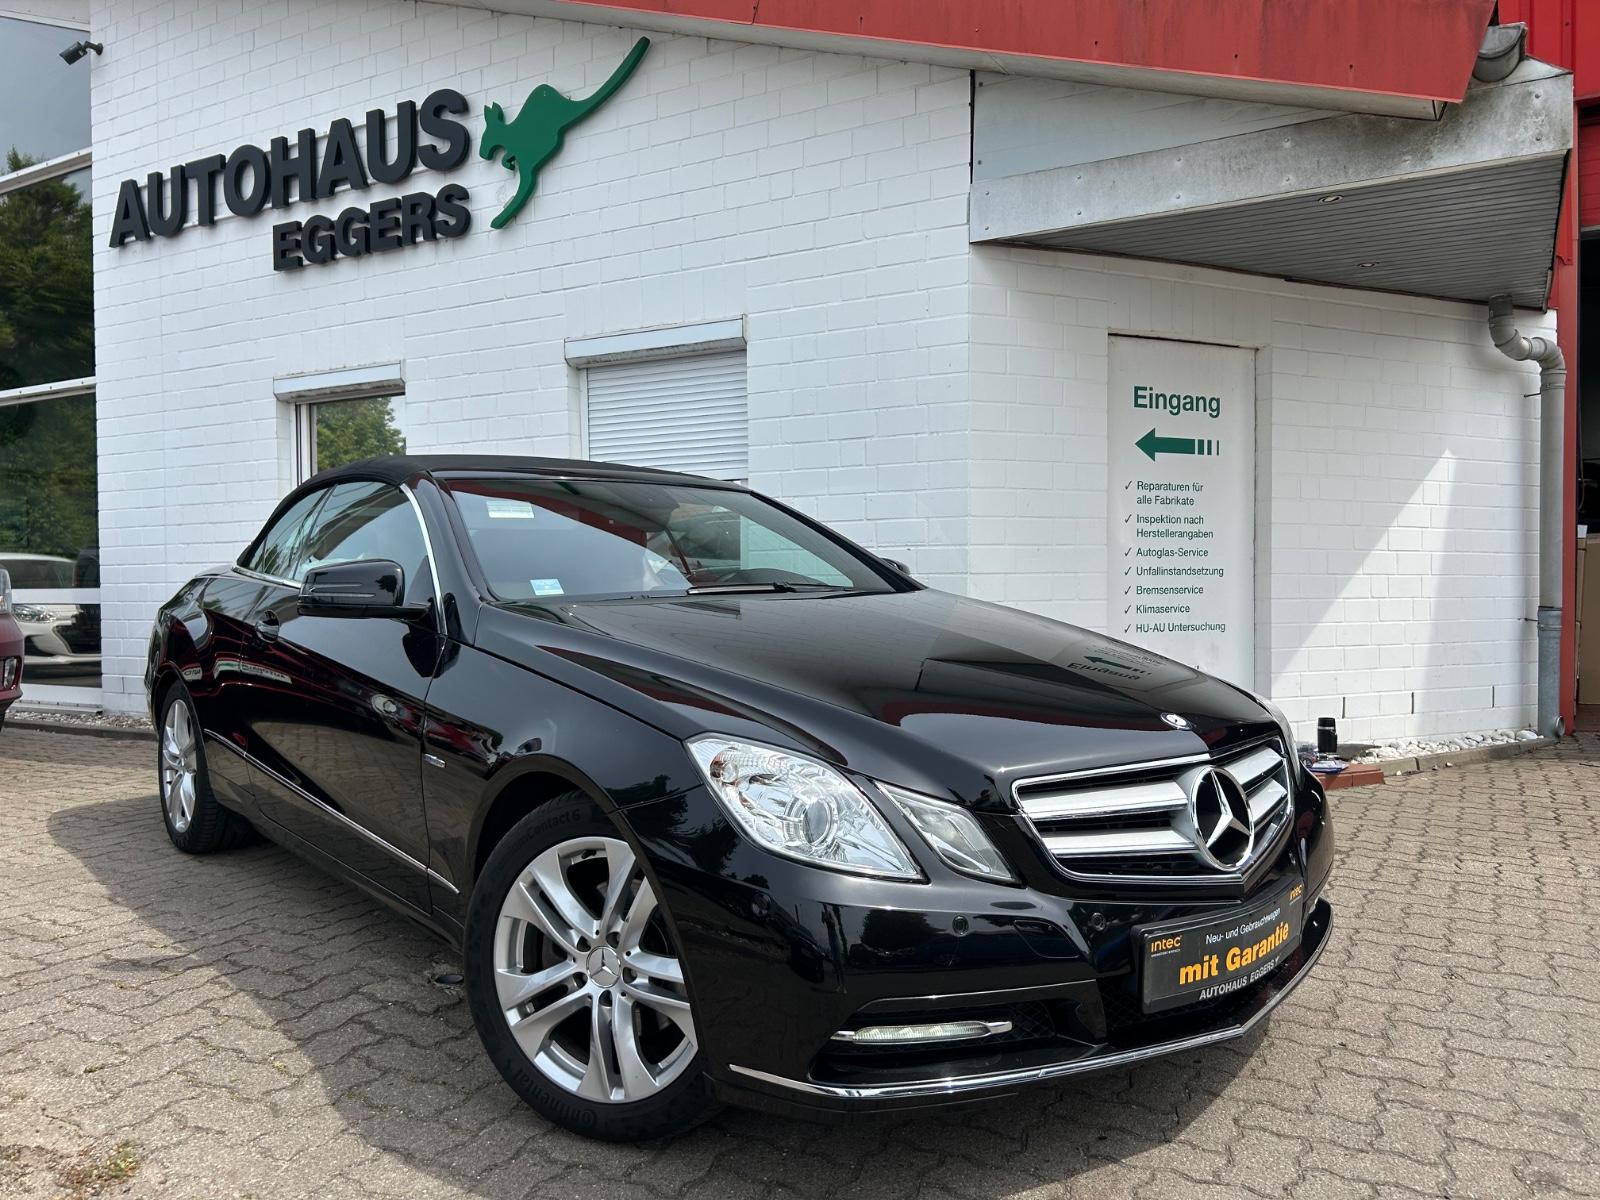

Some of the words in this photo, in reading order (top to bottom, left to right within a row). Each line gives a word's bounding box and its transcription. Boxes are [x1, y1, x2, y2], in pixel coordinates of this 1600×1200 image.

[109, 88, 470, 248] AUTOHAUS
[273, 183, 471, 272] EGGERS
[1133, 386, 1220, 418] Eingang
[1137, 481, 1190, 492] Reparaturen
[1192, 482, 1204, 492] für
[1136, 495, 1152, 504] alle
[1154, 495, 1195, 505] Fabrikate
[1136, 514, 1181, 525] Inspektion
[1184, 515, 1204, 524] nach
[1136, 528, 1214, 540] Herstellerangaben
[1136, 548, 1209, 559] Autoglas-Service
[1136, 566, 1224, 577] Unfallinstandsetzung
[1136, 585, 1204, 595] Bremsenservice
[1136, 605, 1190, 614] Klimaservice
[1136, 623, 1166, 633] HU-AU
[1167, 622, 1226, 632] Untersuchung
[1205, 934, 1224, 945] Neu-
[1225, 927, 1239, 939] und
[1151, 936, 1181, 953] intec
[1179, 954, 1219, 985] mit
[1226, 921, 1289, 971] Garantie
[1199, 976, 1248, 1001] AUTOHAUS
[1249, 959, 1275, 983] EGGERS
[513, 1069, 597, 1126] Continental
